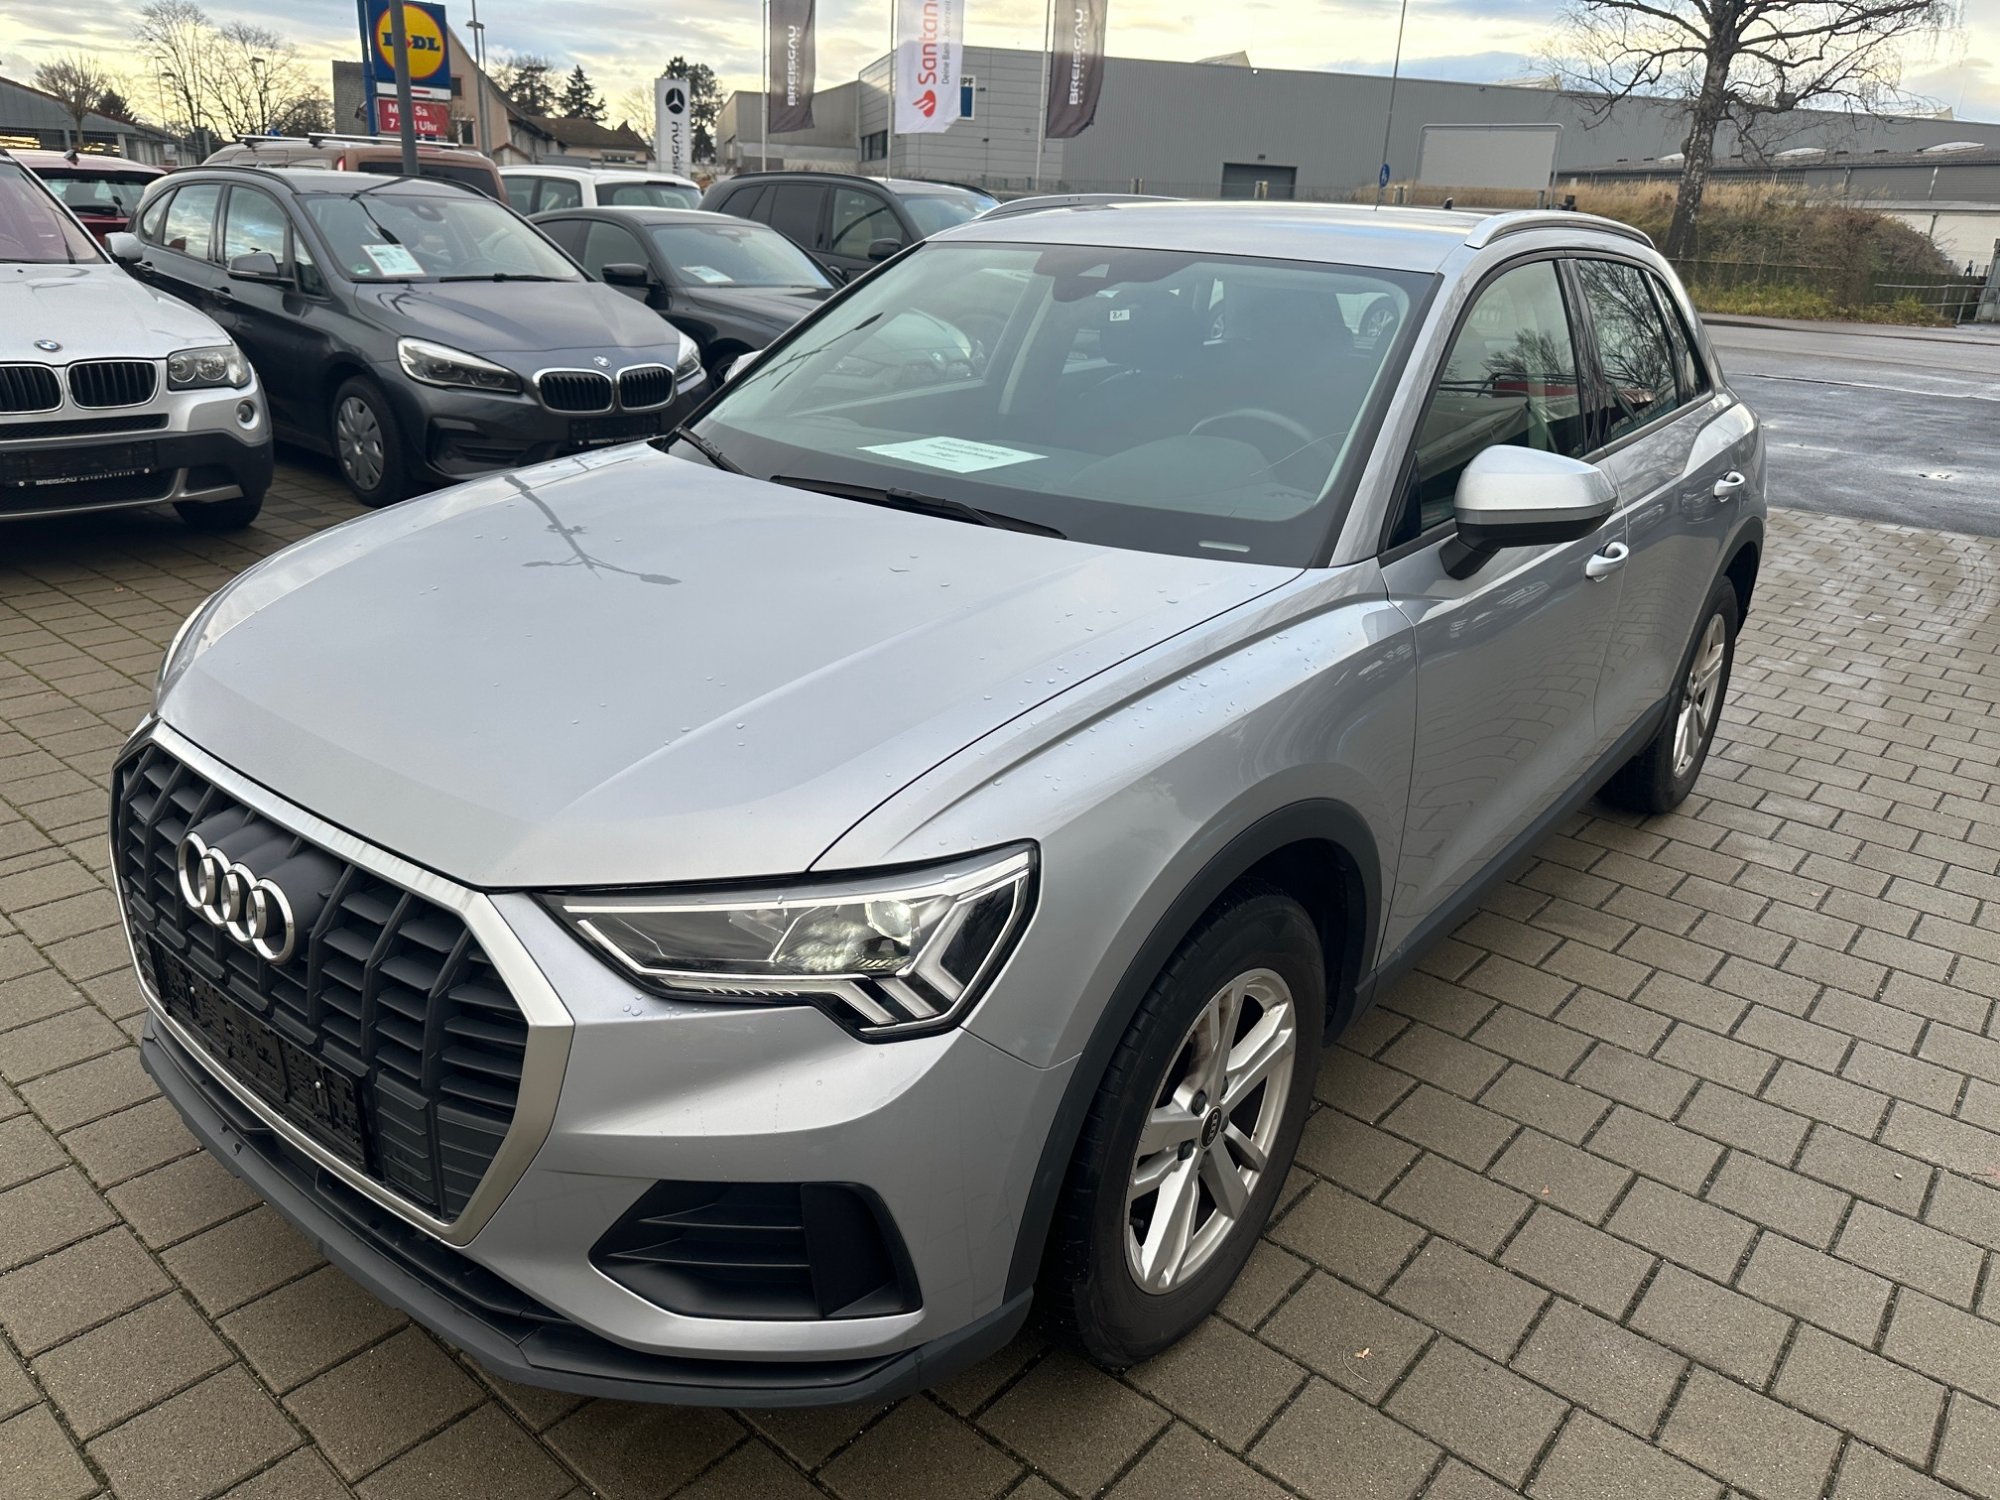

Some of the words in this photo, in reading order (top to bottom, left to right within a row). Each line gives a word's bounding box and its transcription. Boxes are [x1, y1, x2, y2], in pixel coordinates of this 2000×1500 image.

[382, 32, 440, 51] LDL
[787, 25, 796, 106] BREISGAU
[918, 0, 938, 85] Santan
[1069, 8, 1083, 104] BREISGAU
[415, 106, 428, 117] Sa
[419, 121, 438, 132] Uhr
